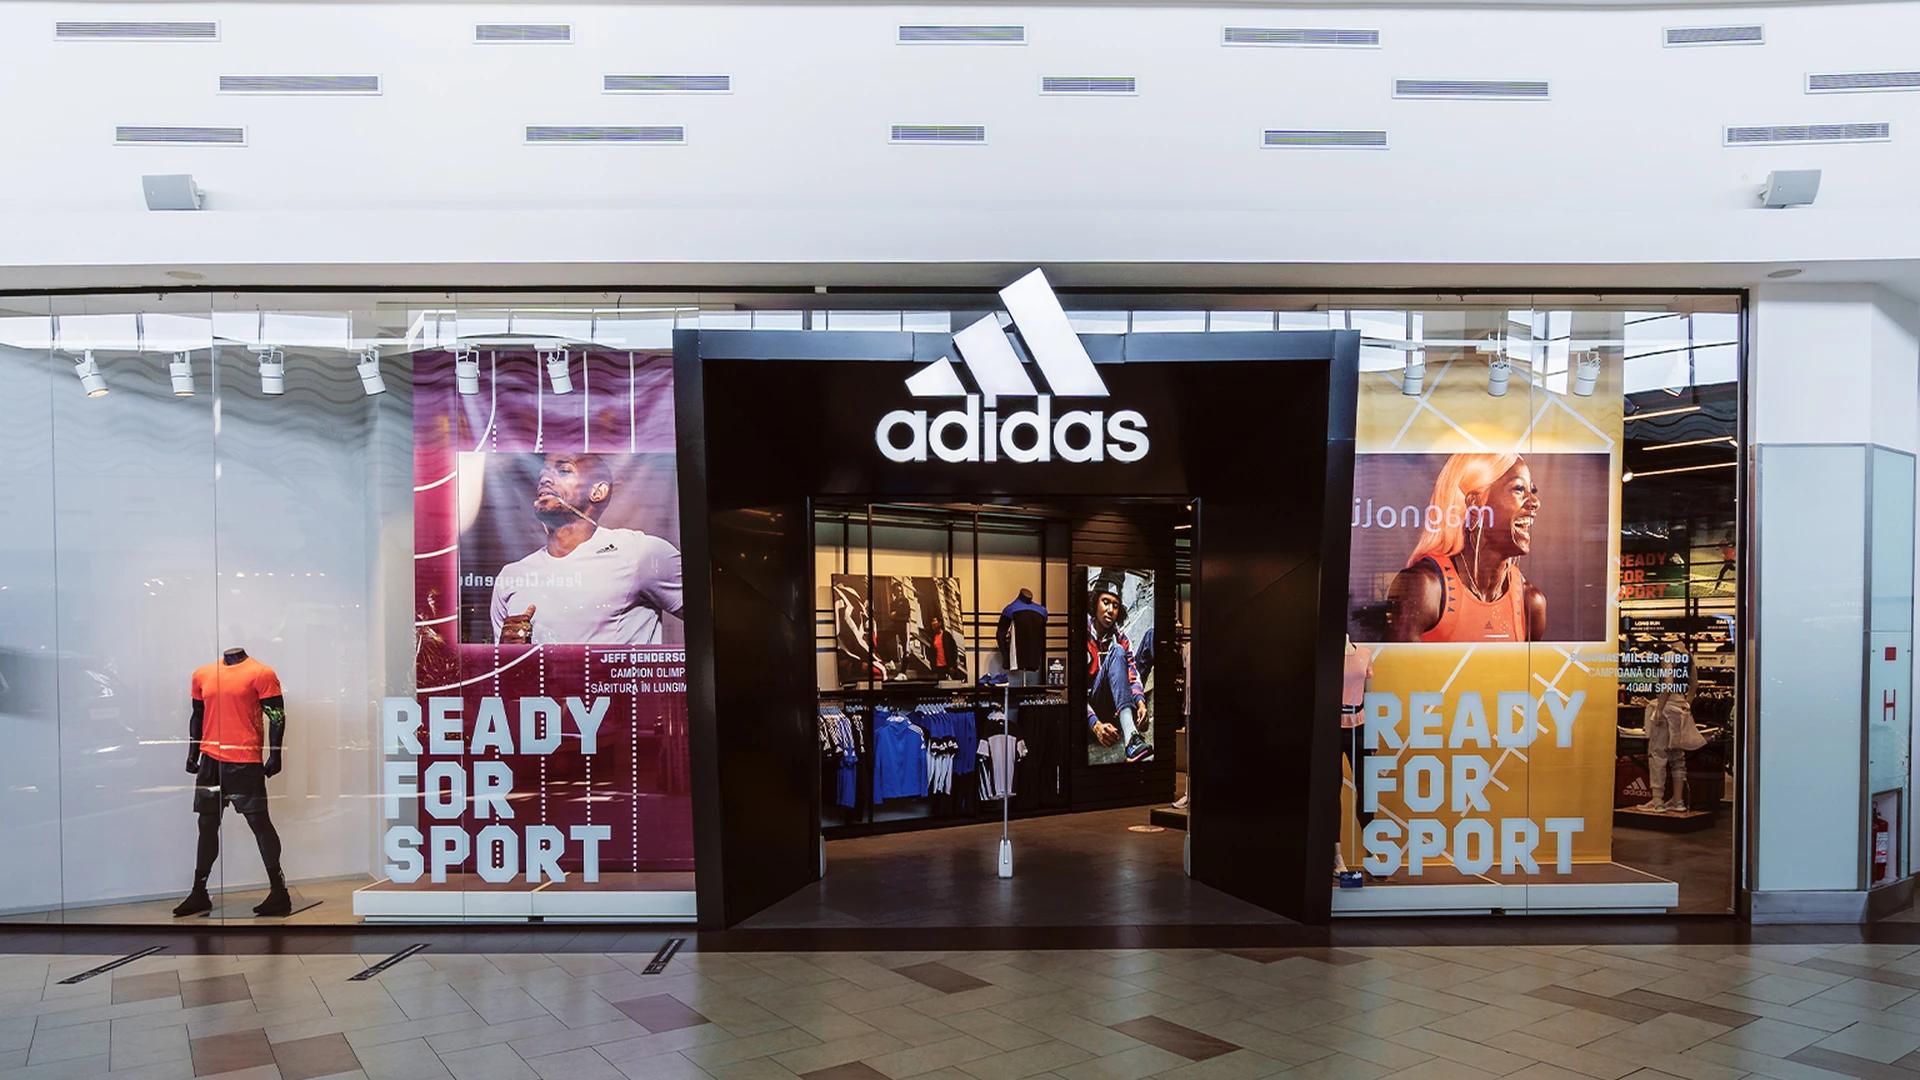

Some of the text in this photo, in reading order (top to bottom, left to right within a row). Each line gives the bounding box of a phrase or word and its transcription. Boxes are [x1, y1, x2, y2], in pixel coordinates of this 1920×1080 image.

[875, 393, 1150, 463] adidas
[600, 653, 627, 664] JEFF
[610, 667, 653, 679] CAMPION
[1626, 683, 1688, 693] 400M SPRINT
[383, 696, 611, 755] READY
[1363, 690, 1586, 749] READY
[1883, 688, 1896, 722] H
[384, 761, 515, 820] FOR
[1363, 754, 1492, 813] FOR
[382, 825, 612, 884] SPORT
[1362, 817, 1585, 877] SPORT
